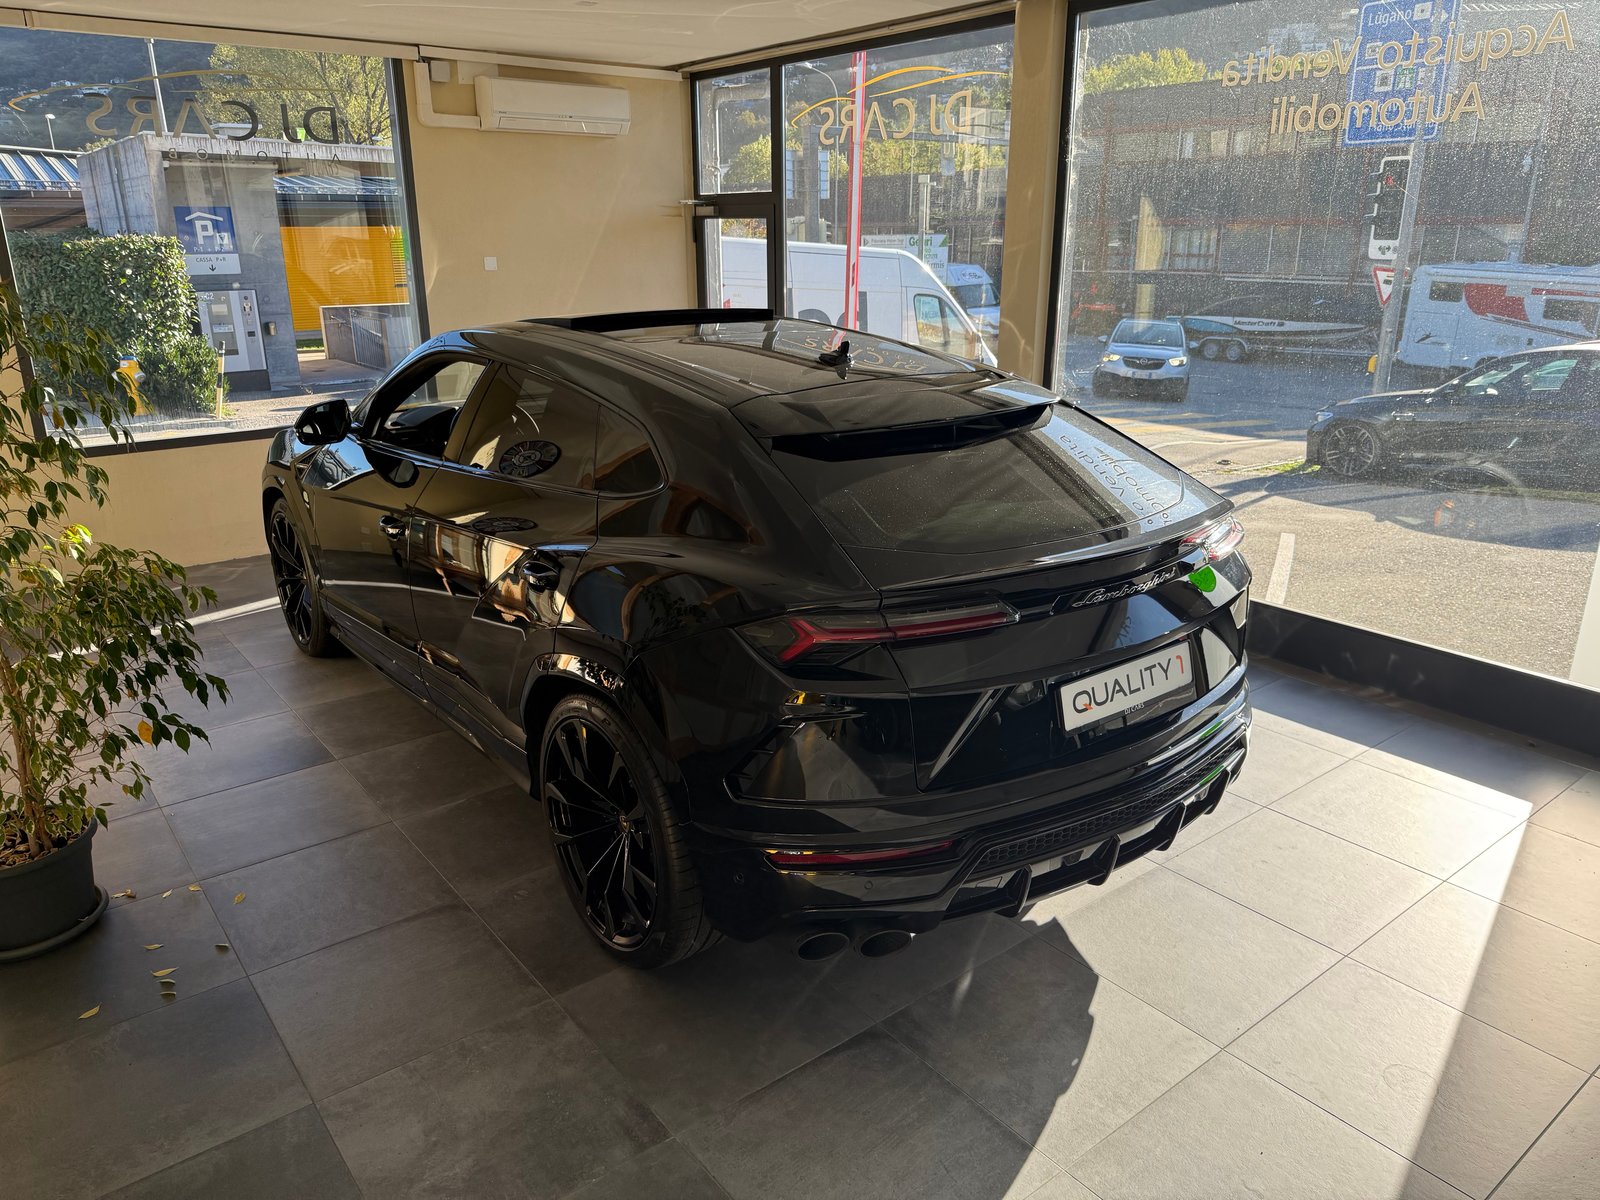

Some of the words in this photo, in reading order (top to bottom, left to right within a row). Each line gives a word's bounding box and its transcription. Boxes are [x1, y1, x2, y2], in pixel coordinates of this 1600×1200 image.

[1368, 9, 1412, 27] Lugano
[1072, 566, 1177, 608] Lamborghini
[1072, 657, 1172, 714] QUALITY
[1175, 654, 1185, 675] 1
